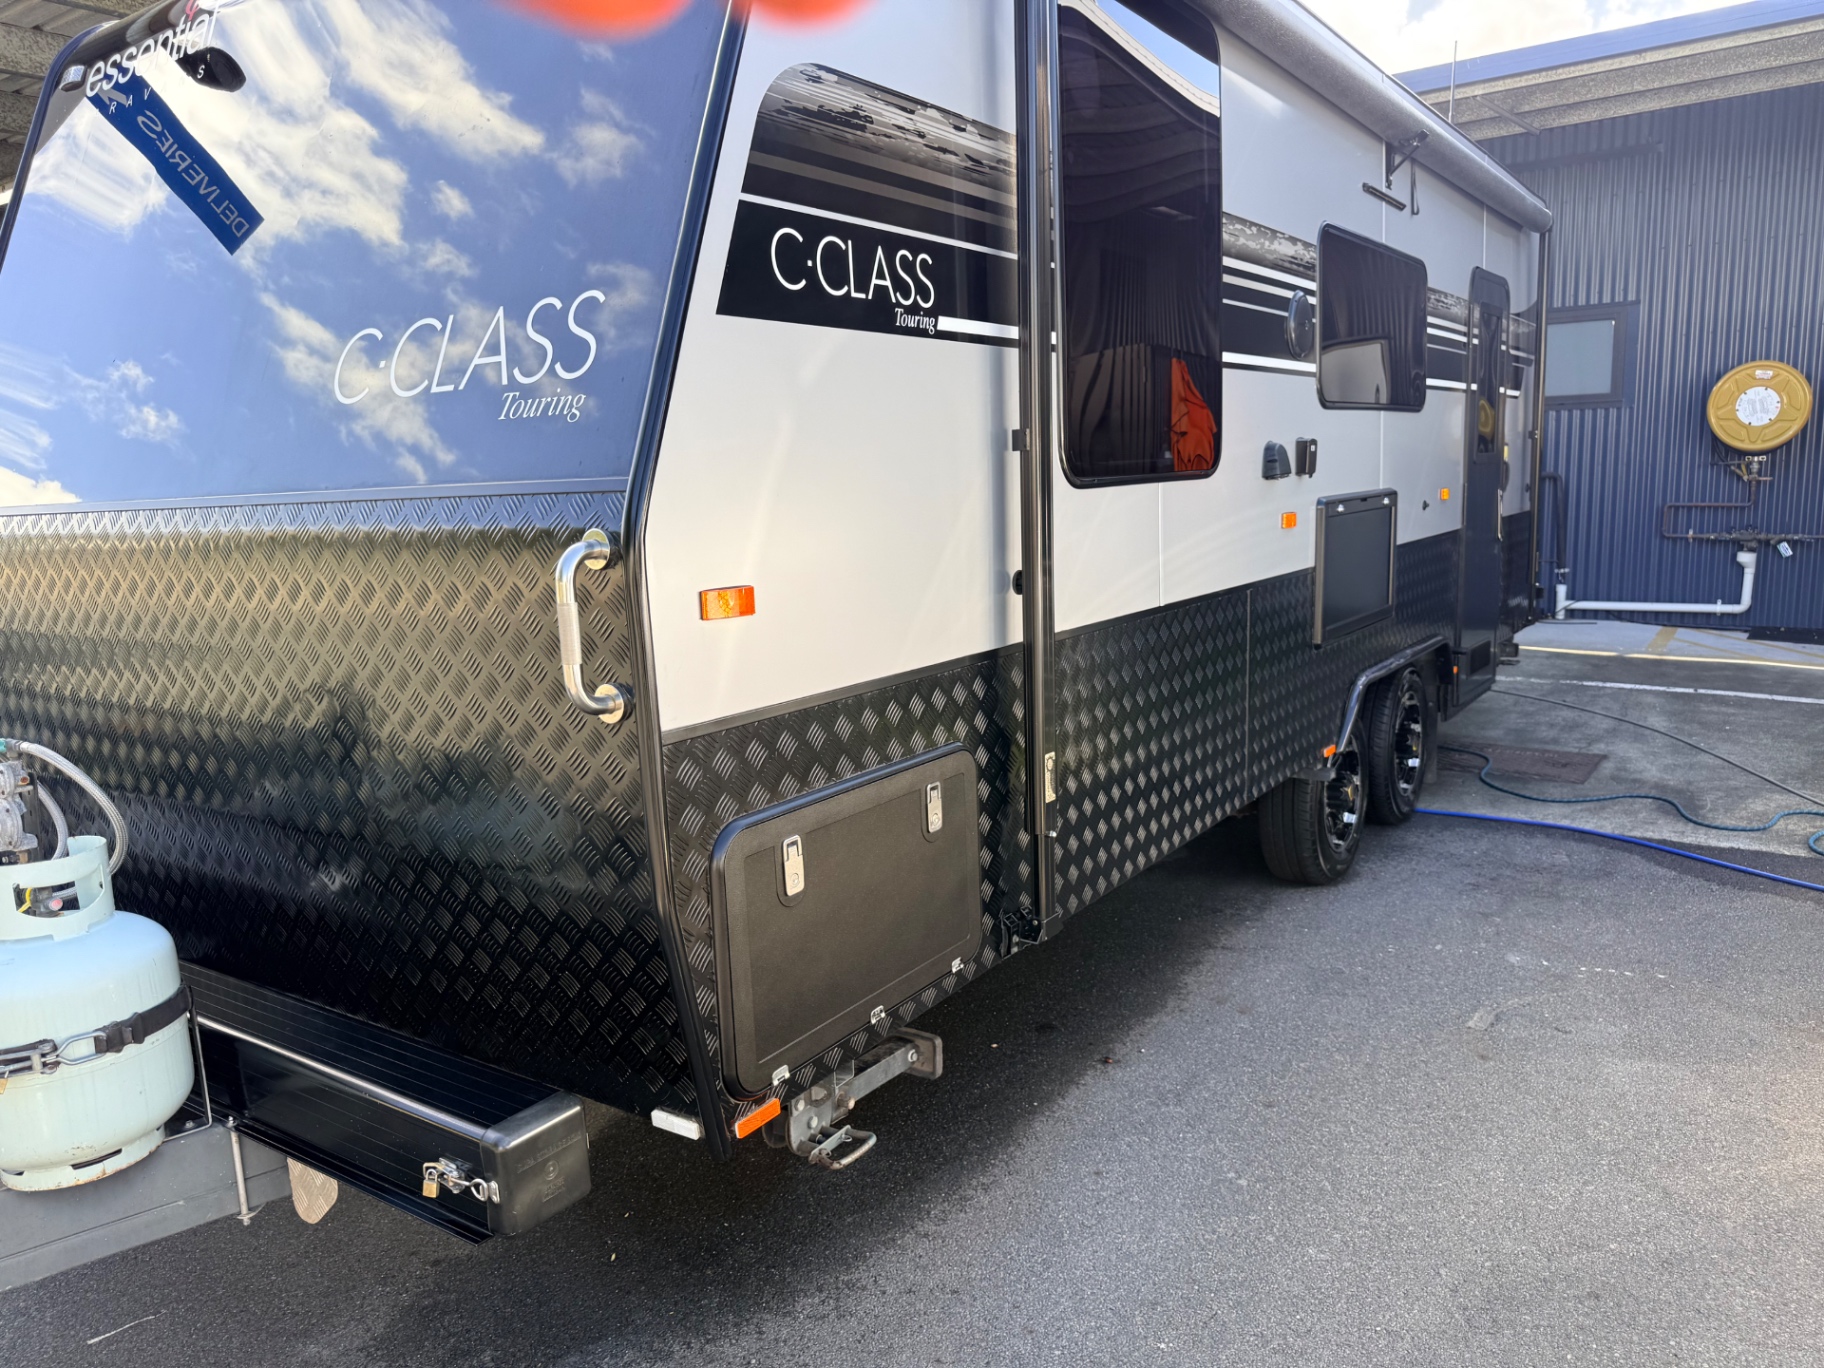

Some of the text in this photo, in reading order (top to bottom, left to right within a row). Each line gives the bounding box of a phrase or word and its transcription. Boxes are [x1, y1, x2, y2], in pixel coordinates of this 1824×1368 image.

[86, 0, 220, 97] essential
[894, 307, 936, 335] Touring
[498, 387, 587, 423] Touring
